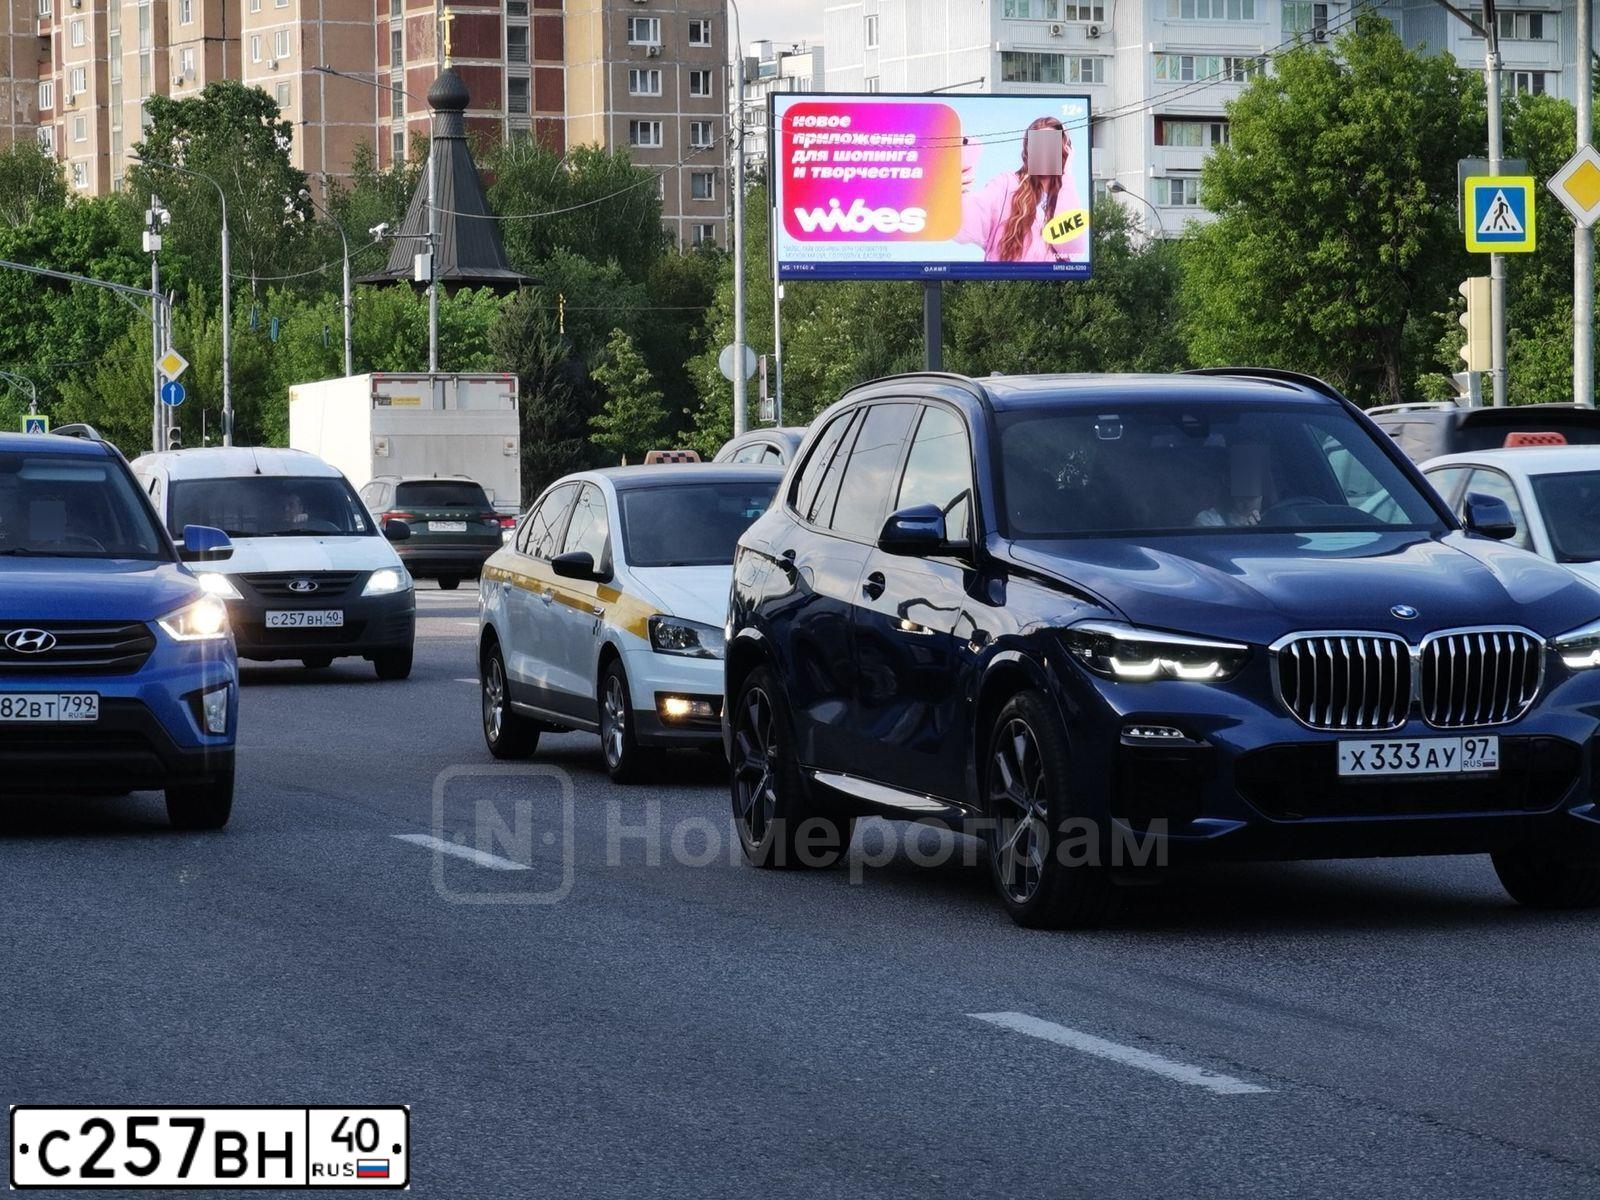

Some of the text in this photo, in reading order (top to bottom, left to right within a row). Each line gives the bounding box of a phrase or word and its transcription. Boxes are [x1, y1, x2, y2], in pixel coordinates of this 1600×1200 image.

[792, 116, 851, 128] новое
[792, 133, 917, 149] приложение
[791, 150, 919, 164] для шопинга
[793, 166, 923, 183] и творчества
[1050, 212, 1084, 240] LIKE
[271, 611, 339, 626] С257ВН 40
[0, 696, 94, 718] 82ВТ 799
[1350, 738, 1490, 771] Х333АУ 97
[1463, 760, 1482, 768] RUS
